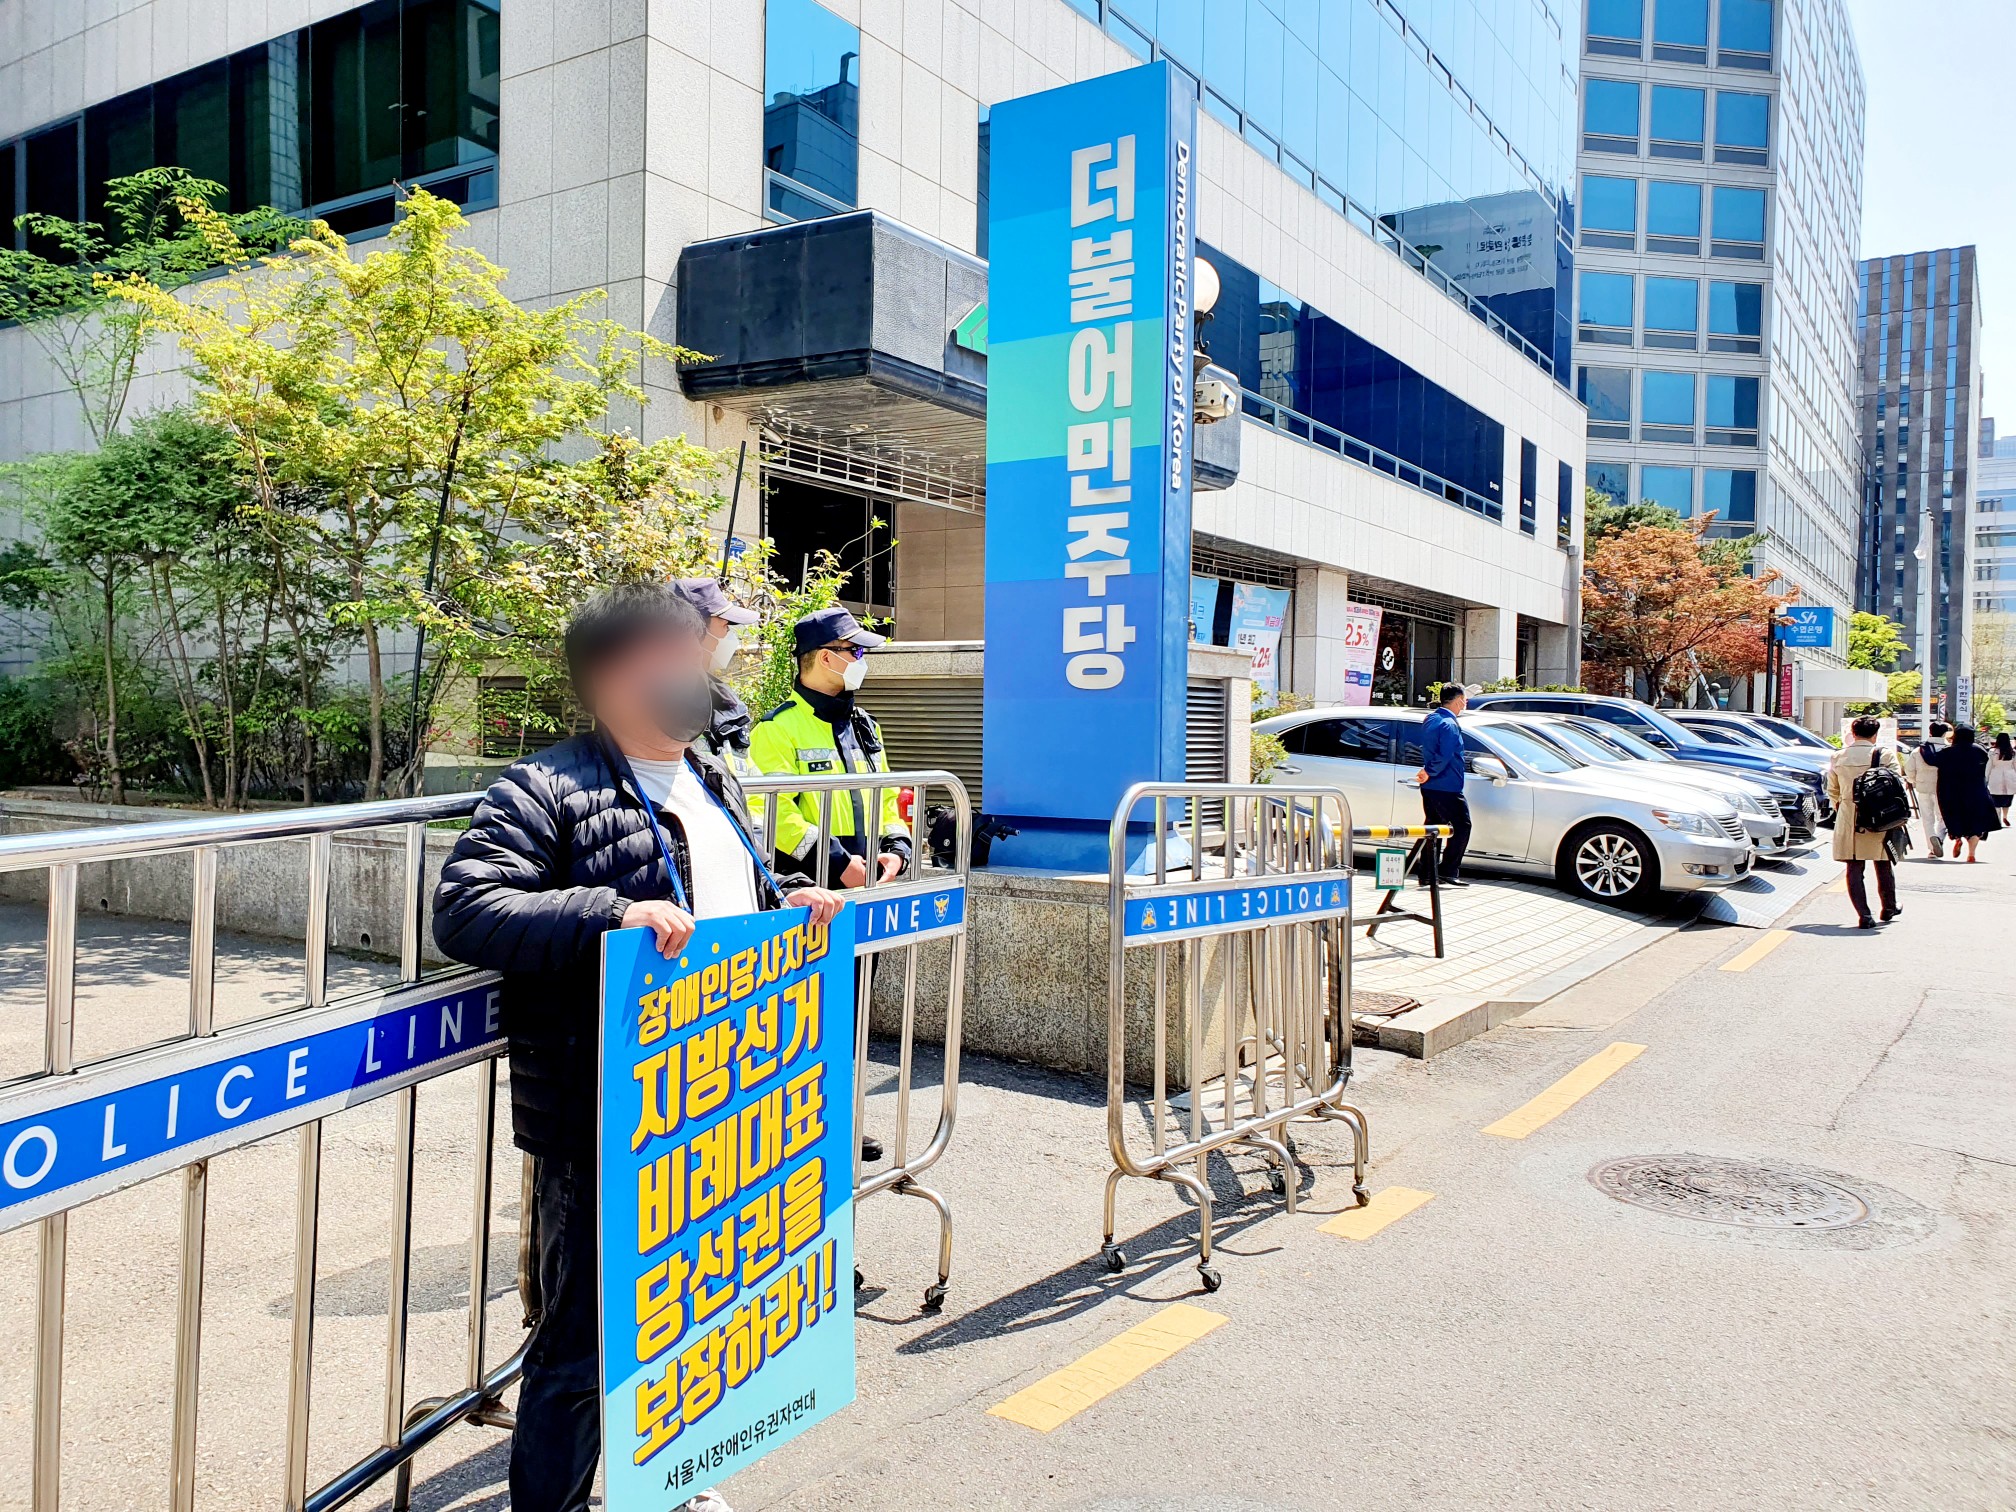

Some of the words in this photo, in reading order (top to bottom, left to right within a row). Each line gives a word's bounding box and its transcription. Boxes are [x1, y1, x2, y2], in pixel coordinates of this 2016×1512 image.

[1175, 140, 1190, 295] Democratic
[1171, 300, 1187, 374] Party
[1063, 133, 1136, 690] 더불어민주당
[1173, 379, 1186, 409] of
[1171, 410, 1185, 490] Korea
[1345, 623, 1369, 646] 2.5%
[1790, 625, 1823, 634] 수협은행
[1797, 611, 1818, 624] Sh
[867, 899, 920, 936] INE
[1168, 895, 1225, 926] LINE
[1241, 885, 1322, 917] POLICE
[637, 920, 830, 1046] 장애인당사자의
[2, 1046, 309, 1190] OLICE
[365, 990, 501, 1074] LINE
[630, 971, 822, 1153] 지방선거
[637, 1060, 825, 1255] 비례대표
[635, 1156, 824, 1363] 당선권을
[633, 1239, 835, 1466] 보장하라!!
[664, 1388, 816, 1490] 서울시장애인유권자연대
